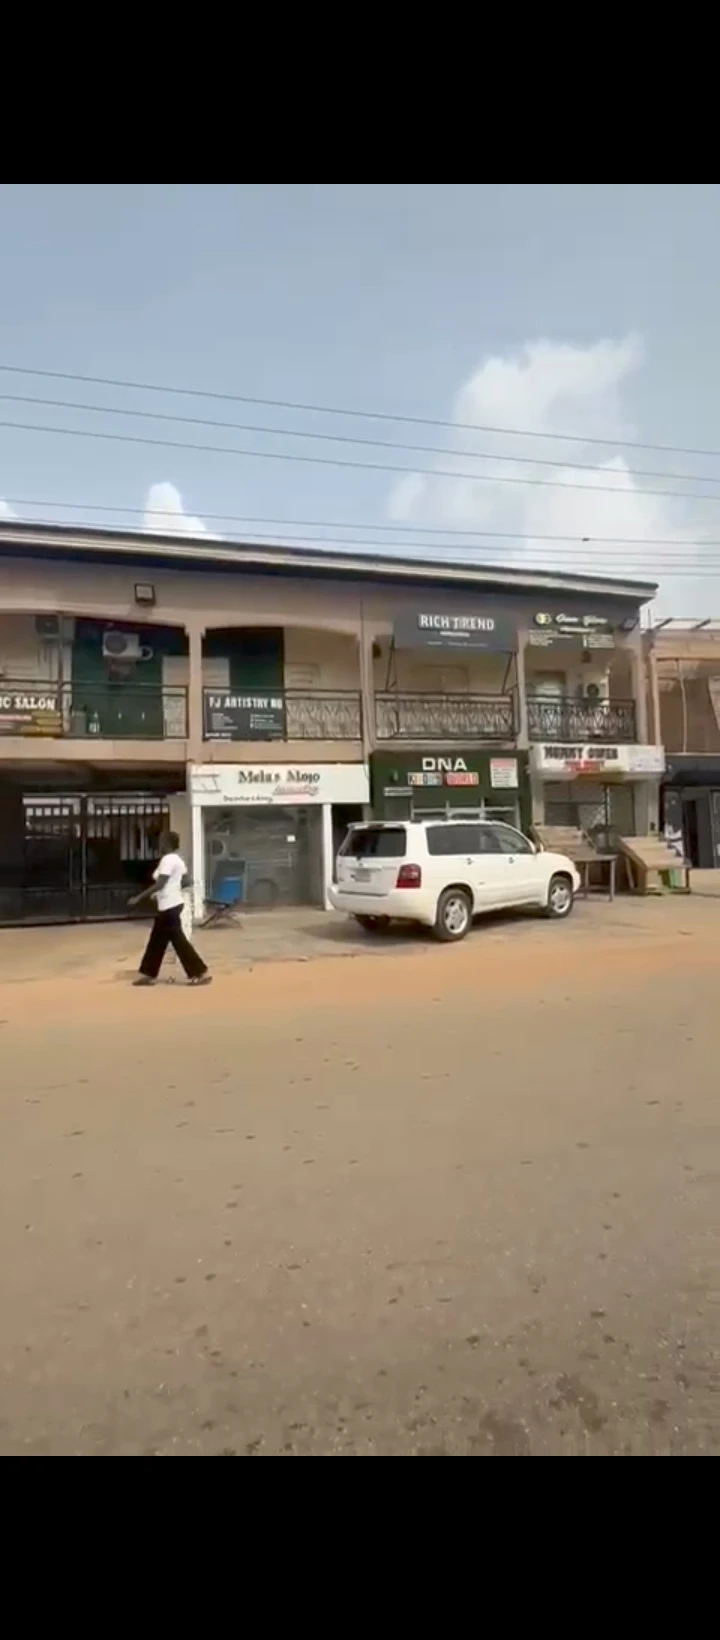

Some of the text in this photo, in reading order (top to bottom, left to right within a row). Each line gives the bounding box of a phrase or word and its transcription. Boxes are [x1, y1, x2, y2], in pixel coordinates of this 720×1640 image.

[420, 614, 495, 631] RICH TREND
[14, 696, 55, 710] SALON
[422, 757, 468, 771] DNA
